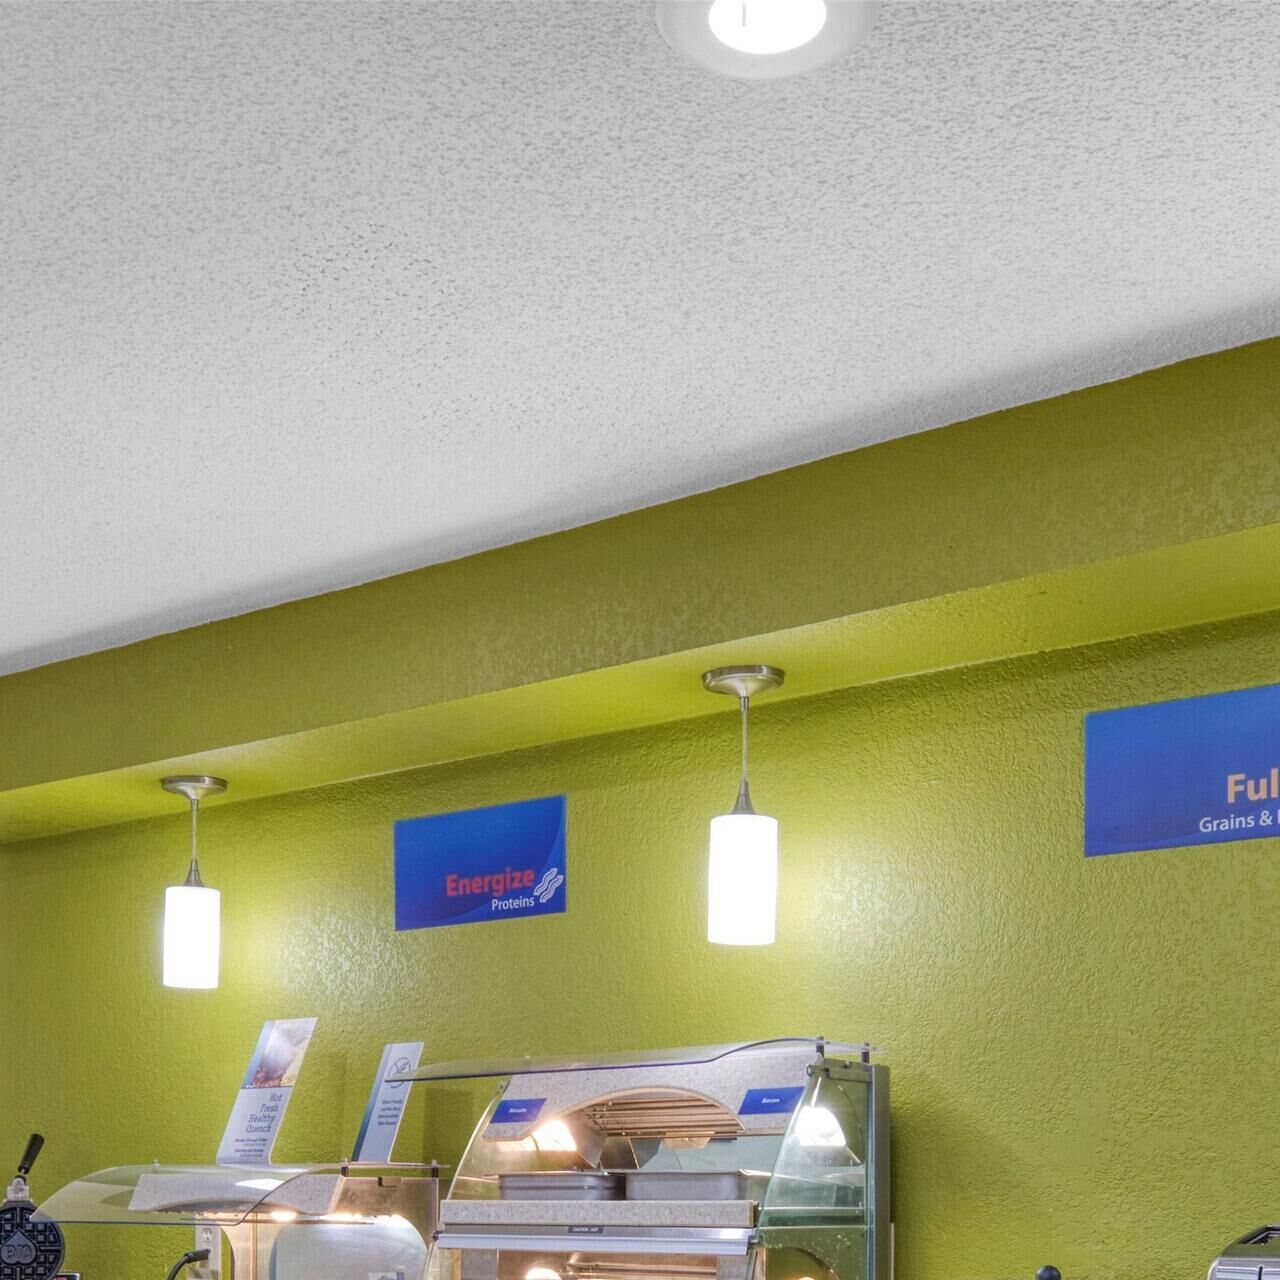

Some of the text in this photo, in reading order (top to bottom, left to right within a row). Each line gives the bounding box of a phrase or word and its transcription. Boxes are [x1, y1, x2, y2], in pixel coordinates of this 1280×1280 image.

[1199, 815, 1255, 833] Grains
[1259, 809, 1273, 826] &
[446, 866, 535, 896] Energize
[491, 896, 535, 911] Proteins
[260, 1103, 279, 1113] Fresh
[248, 1113, 276, 1123] Healthy
[245, 1123, 271, 1133] Quench
